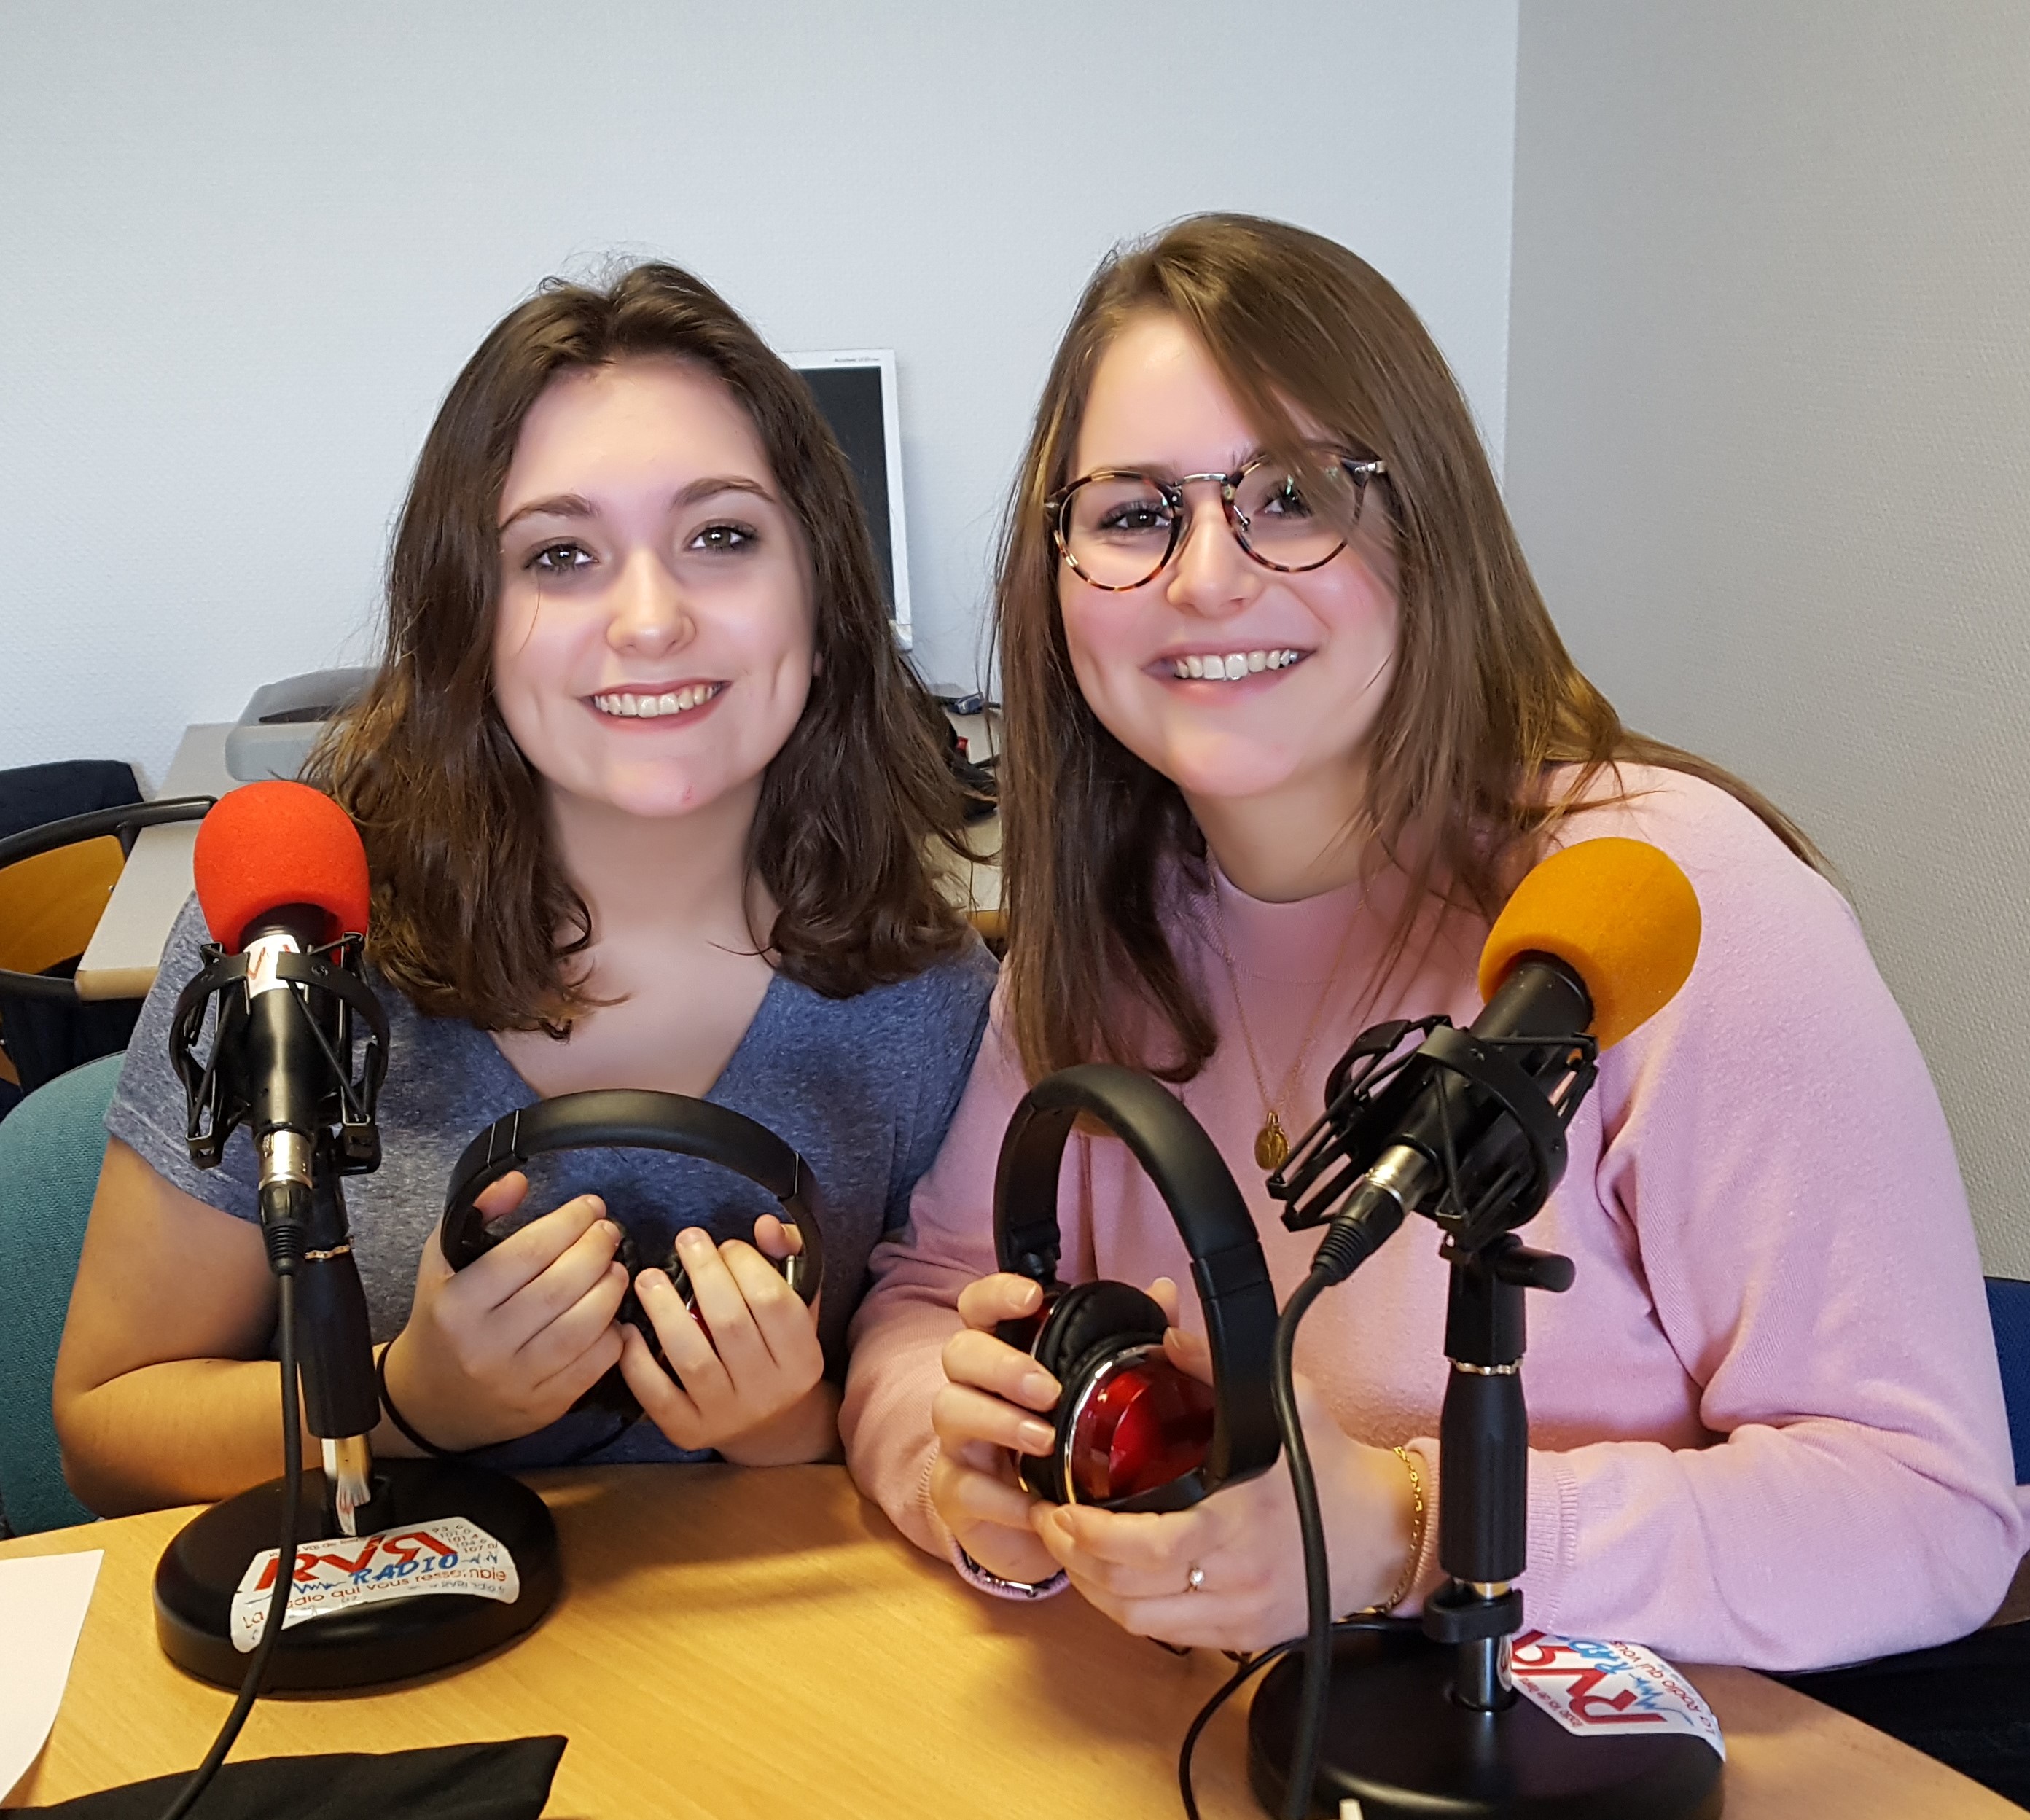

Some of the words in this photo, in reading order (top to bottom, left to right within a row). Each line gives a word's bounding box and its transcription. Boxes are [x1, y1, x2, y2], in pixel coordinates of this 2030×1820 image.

[348, 1553, 459, 1585] RADIO
[242, 1611, 265, 1629] La
[331, 1586, 362, 1598] qui
[367, 1577, 410, 1590] vous
[1639, 1662, 1664, 1679] qui
[1662, 1679, 1702, 1713] Radio
[1699, 1716, 1716, 1735] La
